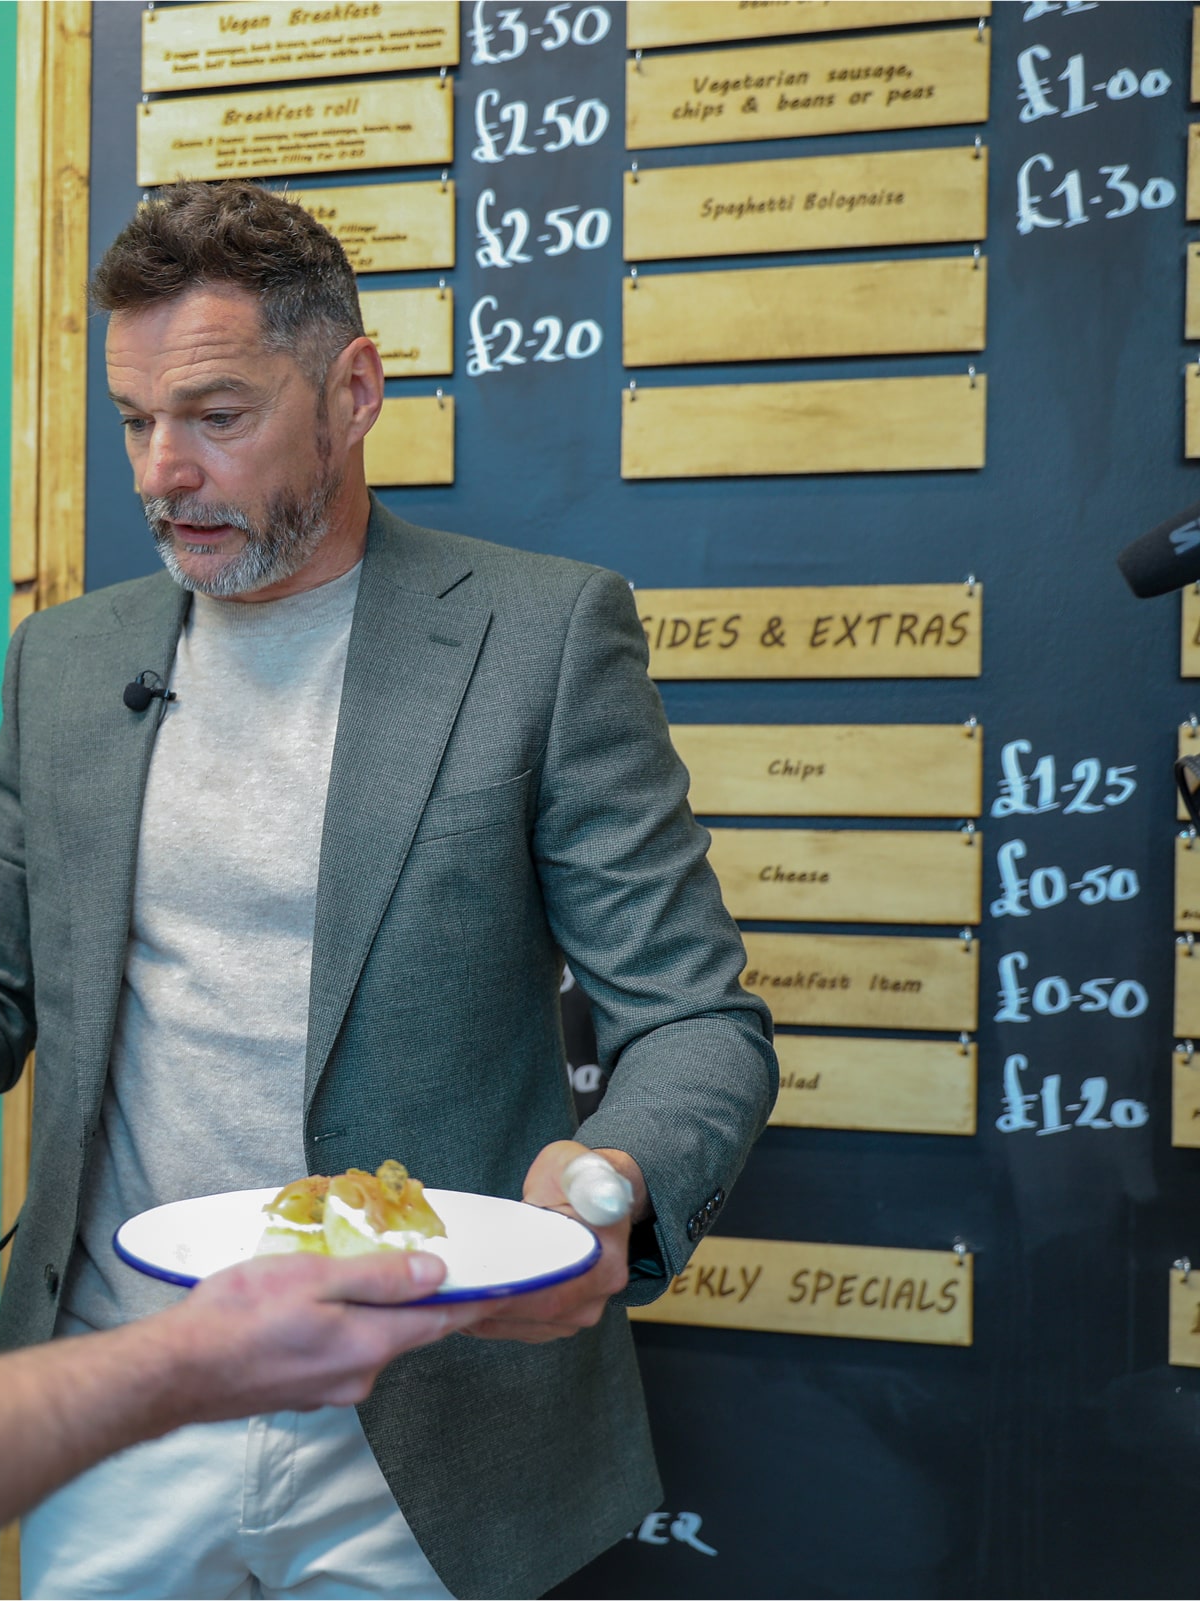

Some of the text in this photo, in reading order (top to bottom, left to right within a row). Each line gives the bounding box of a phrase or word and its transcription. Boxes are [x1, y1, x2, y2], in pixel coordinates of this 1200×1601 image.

[218, 3, 381, 35] Vegan Breakfast
[693, 62, 914, 96] Vegetarian sausage,
[222, 97, 361, 127] Breakfast roll
[671, 84, 936, 123] chips & beans or peas
[700, 188, 906, 221] Spaghetti Bolognaise
[760, 614, 786, 648] &
[808, 610, 970, 650] EXTRAS
[766, 756, 827, 779] Chips
[758, 864, 831, 885] Cheese
[744, 969, 924, 994] Breakfast Item
[673, 1263, 960, 1315] EKLY SPECIALS
